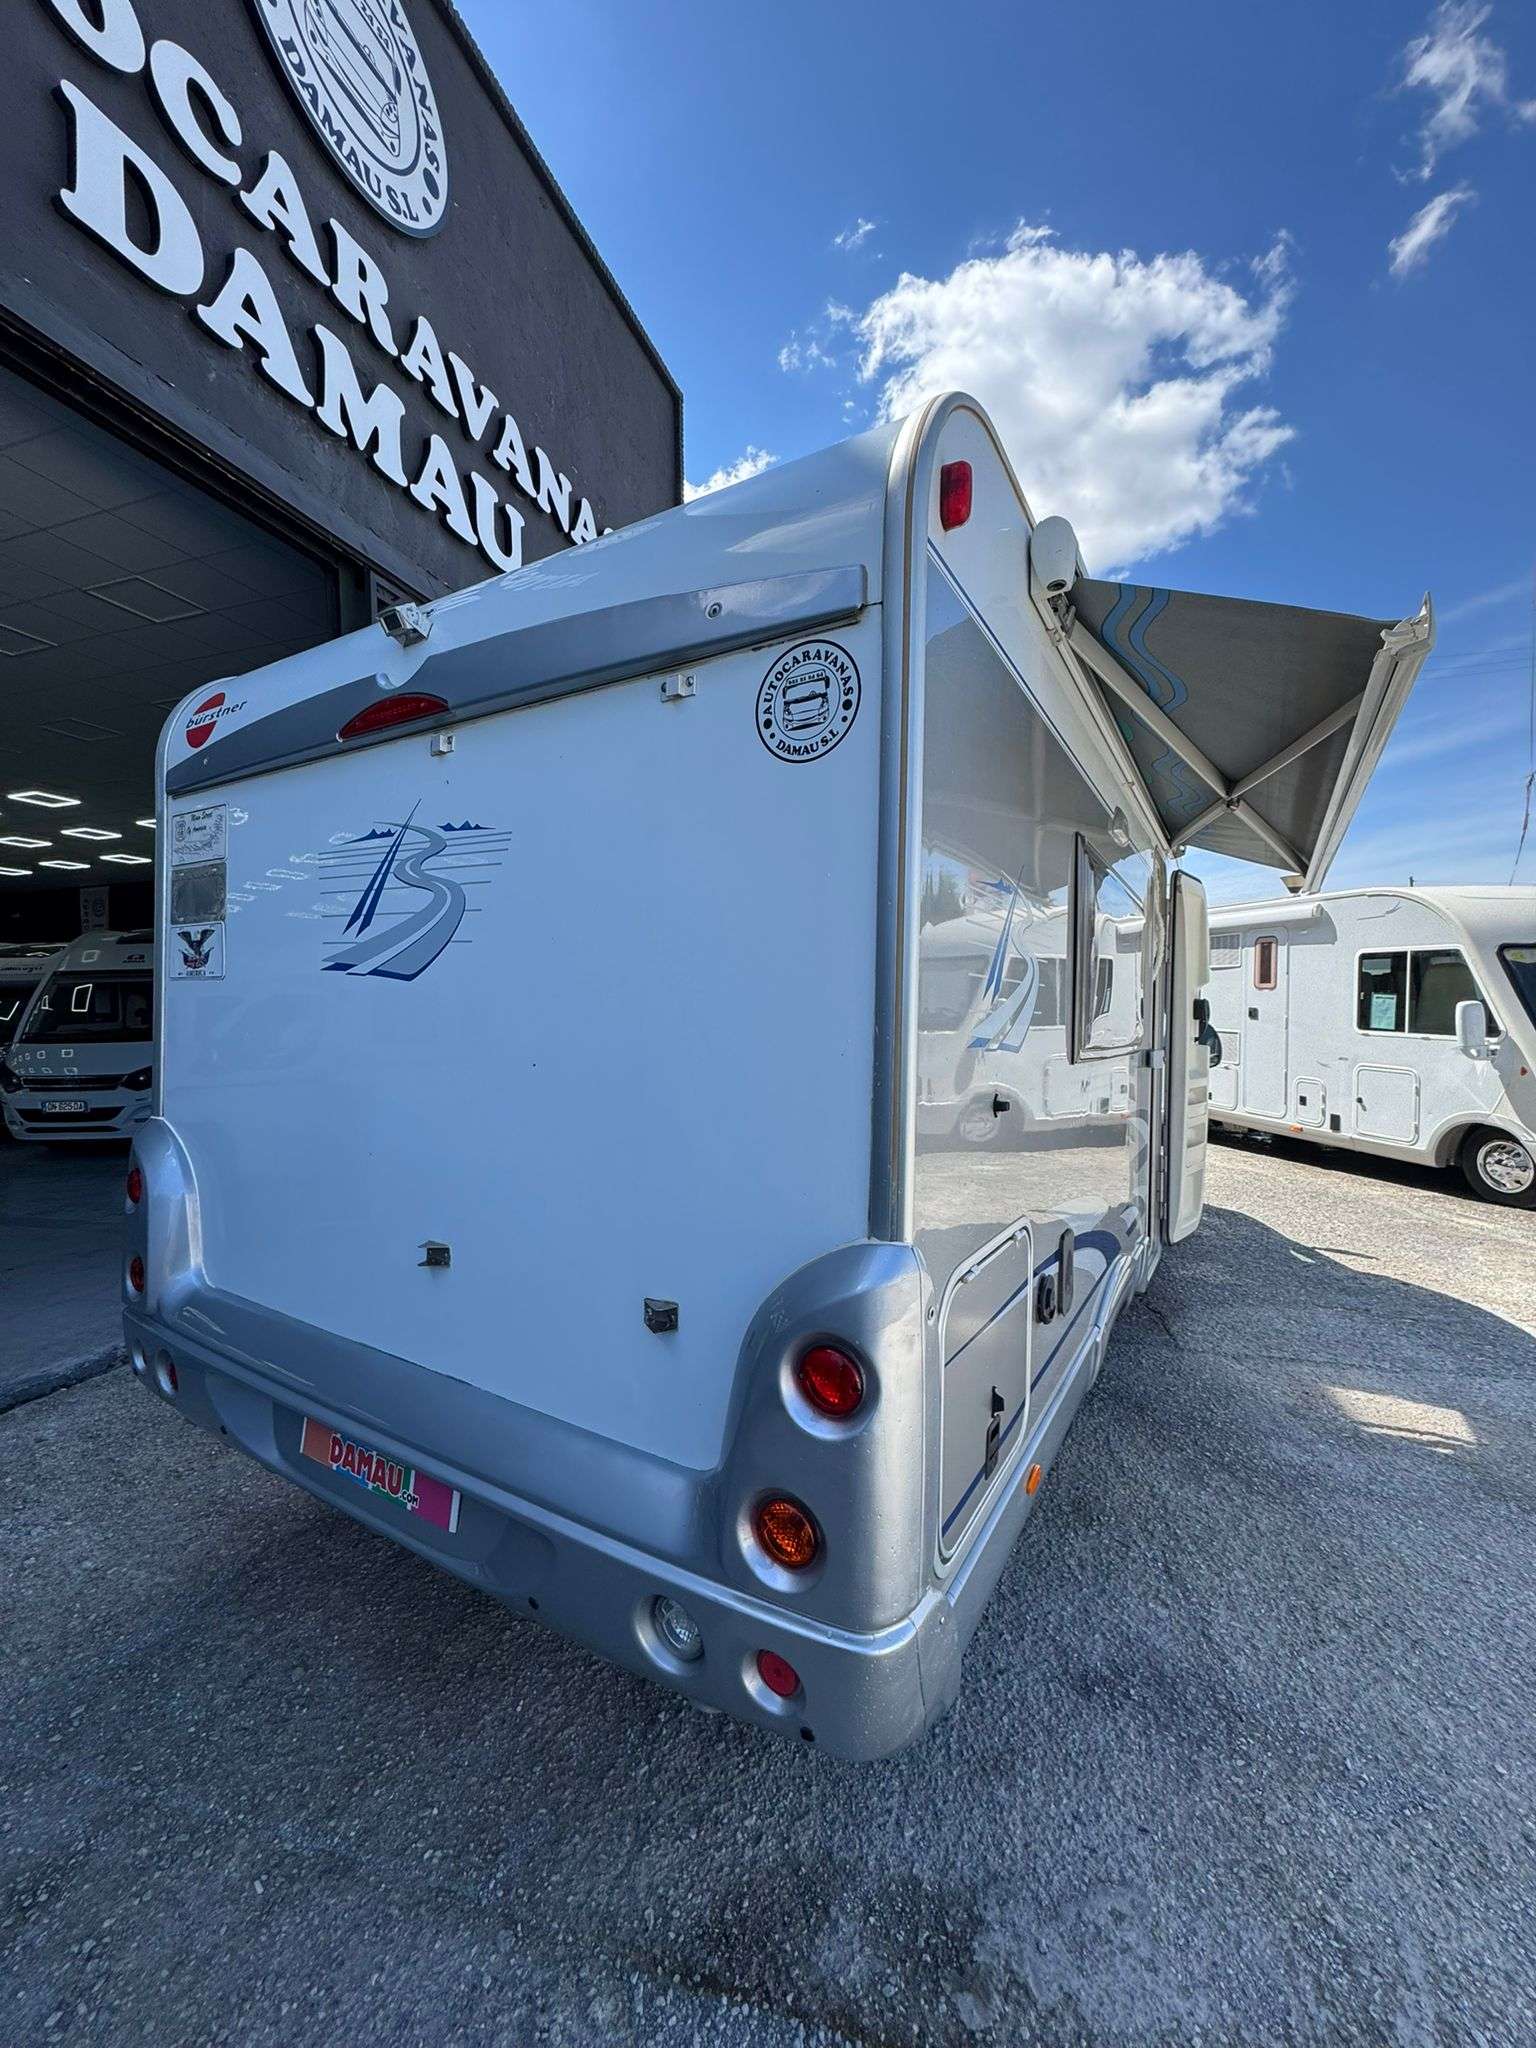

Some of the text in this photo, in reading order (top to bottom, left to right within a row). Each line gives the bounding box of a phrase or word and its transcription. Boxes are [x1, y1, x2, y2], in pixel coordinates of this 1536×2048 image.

[278, 36, 381, 199] DAMAU
[60, 79, 524, 572] DAMAU
[763, 649, 853, 715] AUTOCARAVANAS
[776, 739, 819, 756] DAMAU
